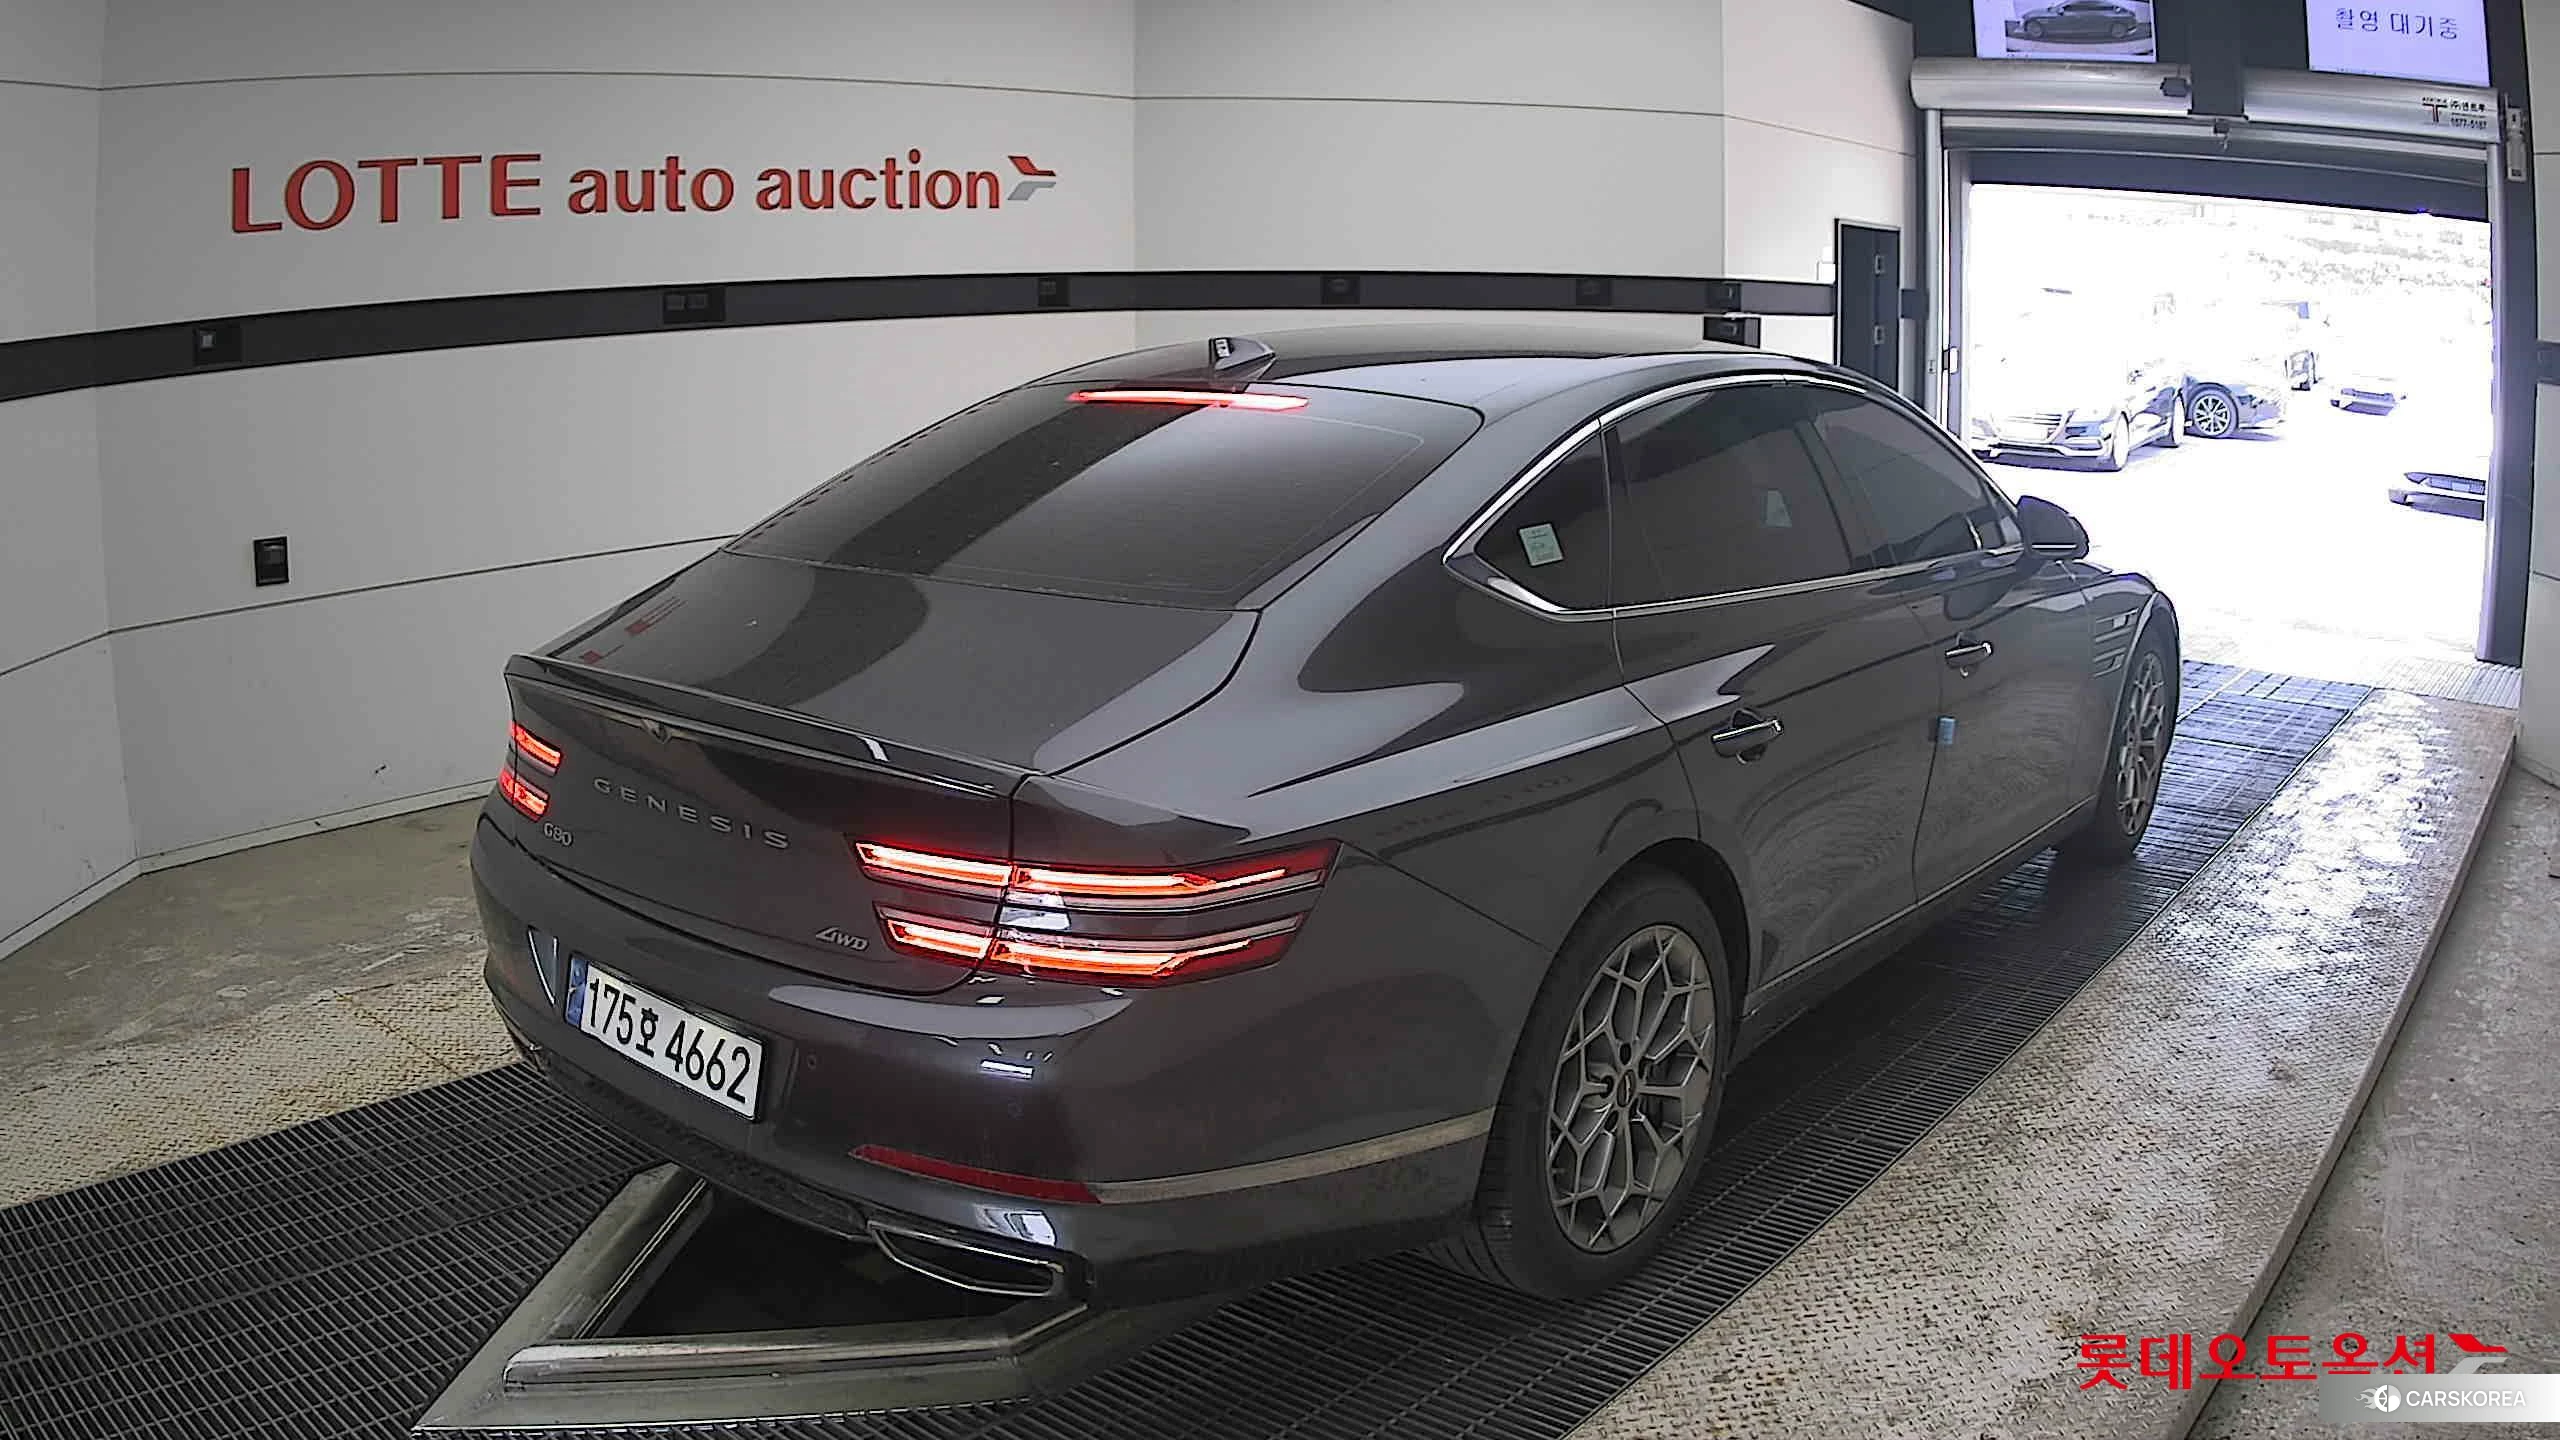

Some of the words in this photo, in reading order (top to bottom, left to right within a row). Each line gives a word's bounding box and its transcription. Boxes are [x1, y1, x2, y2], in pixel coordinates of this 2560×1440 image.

[2336, 7, 2379, 33] 촬영
[231, 153, 541, 234] LOTTE
[568, 155, 735, 214] auto
[756, 148, 1001, 211] auction
[543, 822, 573, 846] G80
[593, 777, 789, 849] GENESIS
[589, 978, 659, 1058] 175호
[665, 1020, 751, 1104] 4662
